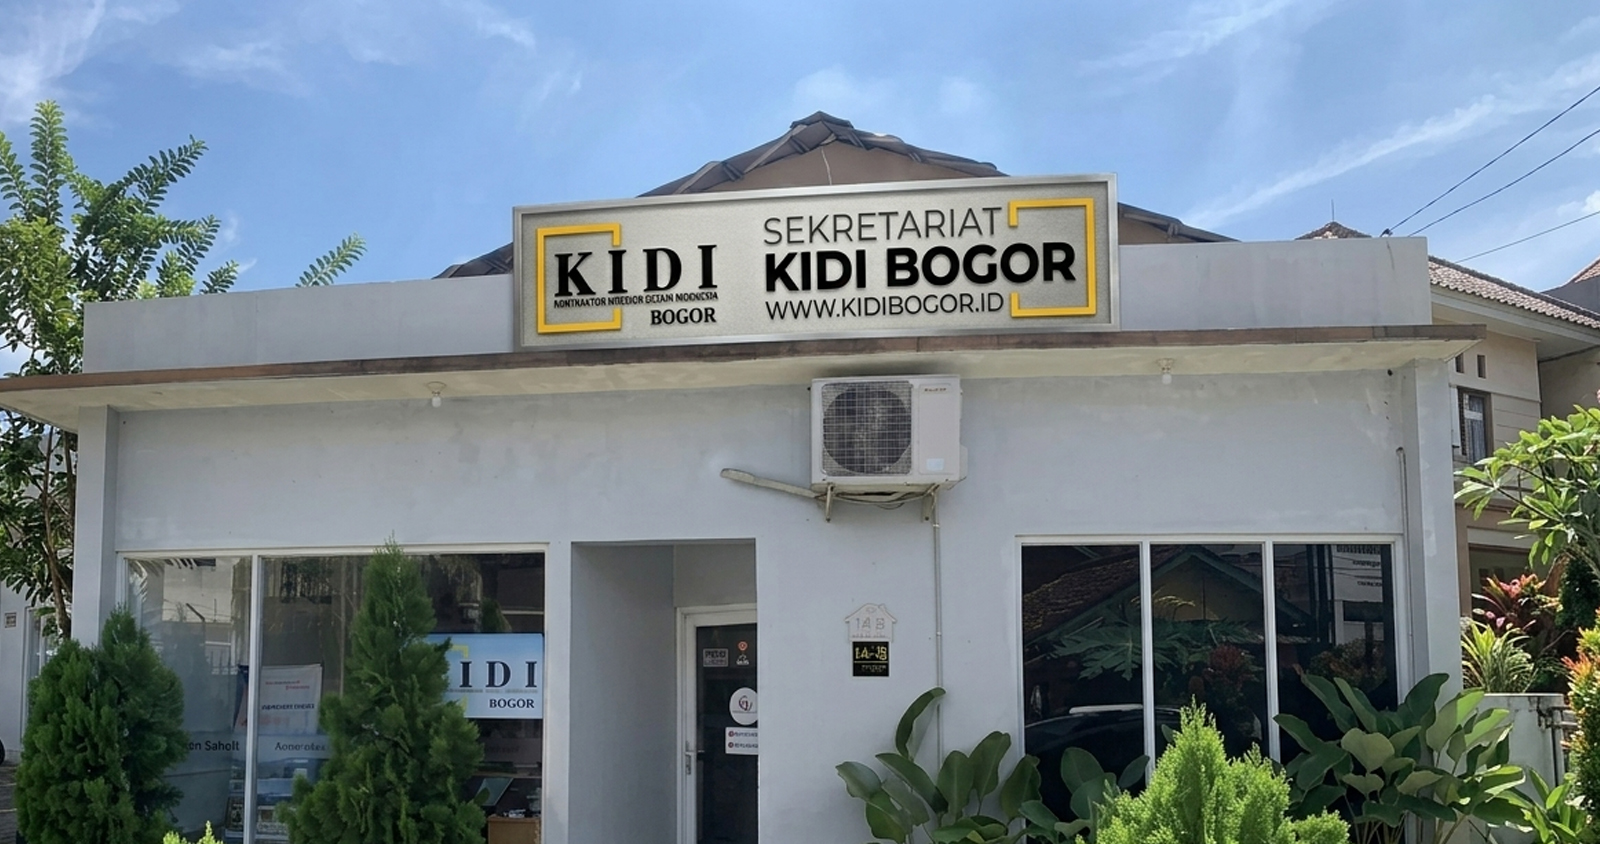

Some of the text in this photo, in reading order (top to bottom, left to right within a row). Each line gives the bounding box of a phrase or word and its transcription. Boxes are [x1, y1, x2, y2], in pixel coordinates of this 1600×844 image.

[763, 206, 1002, 246] SEKRETARIAT
[554, 243, 718, 298] KIDI
[765, 241, 1077, 293] KIDI BOGOR
[650, 306, 717, 326] BOGOR
[764, 291, 1005, 321] WWW.KIDIBOGOR.ID
[489, 698, 535, 709] BOGOR
